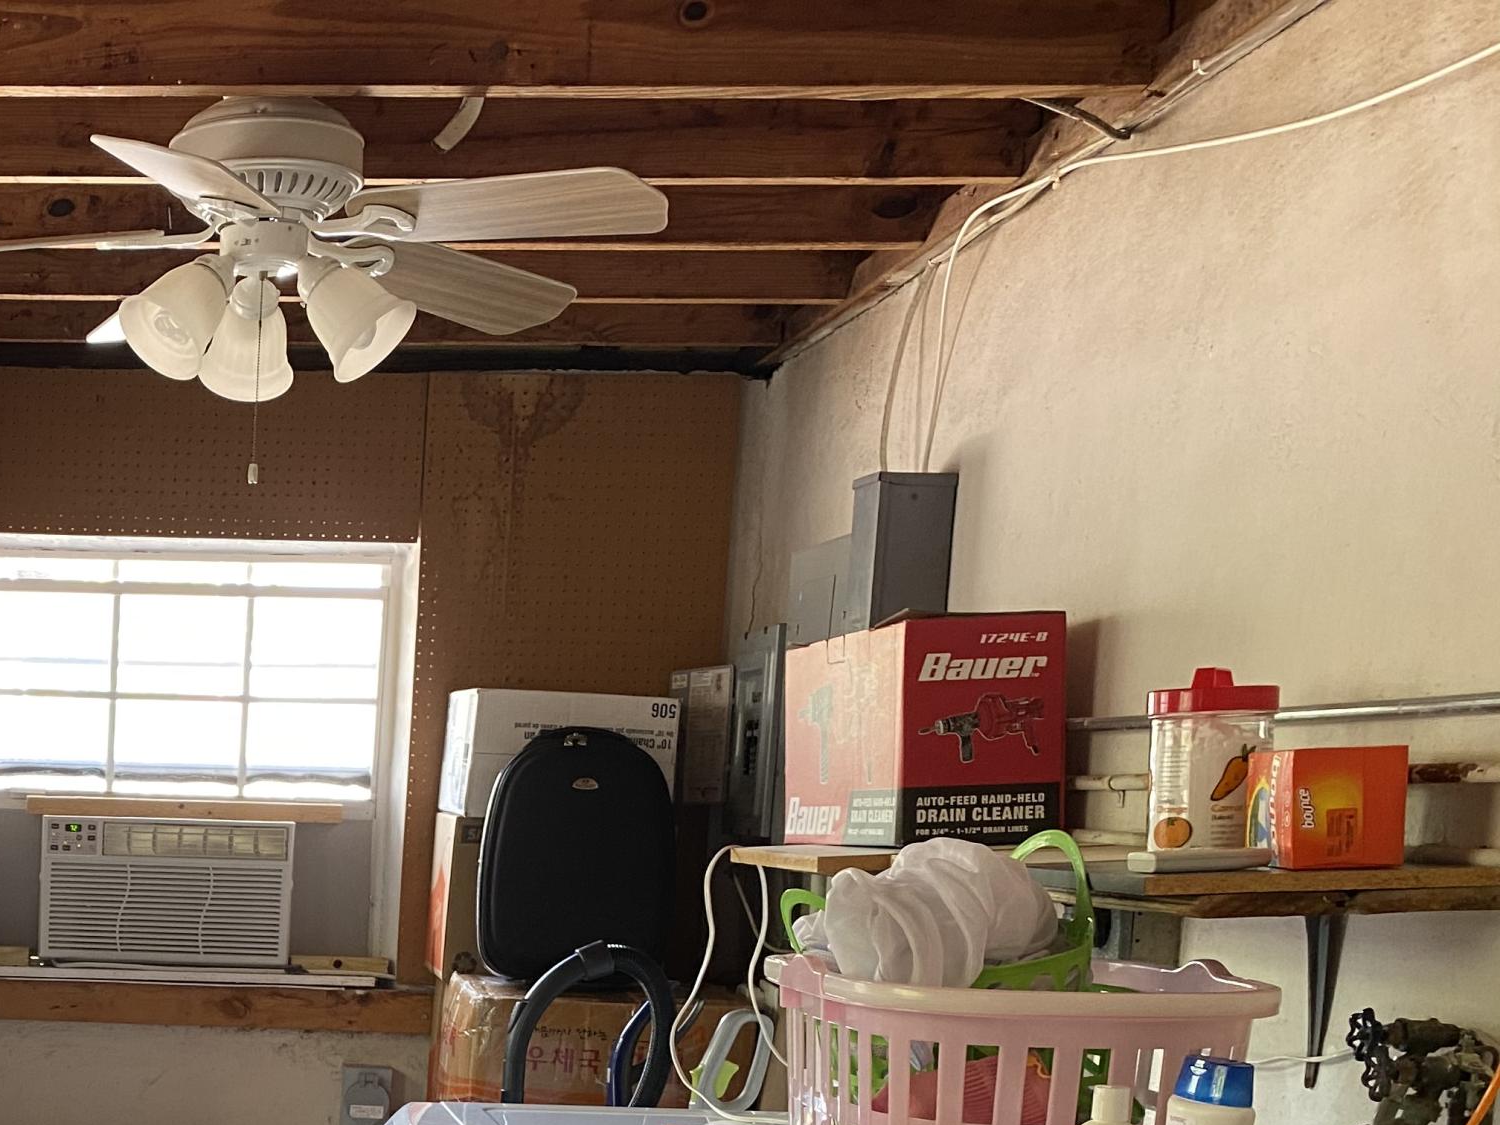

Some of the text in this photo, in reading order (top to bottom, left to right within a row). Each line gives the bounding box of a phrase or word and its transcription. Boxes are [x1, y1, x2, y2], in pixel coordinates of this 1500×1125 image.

[979, 631, 1049, 645] 1724E-B
[917, 652, 1049, 683] Bauer
[651, 703, 677, 719] 506
[915, 792, 1046, 808] AUTO-FEED HAND-HELD
[1299, 787, 1316, 830] bounce
[785, 796, 841, 836] Bauer
[916, 805, 1046, 825] DRAIN CLEANER
[526, 1046, 601, 1074] 우체국
